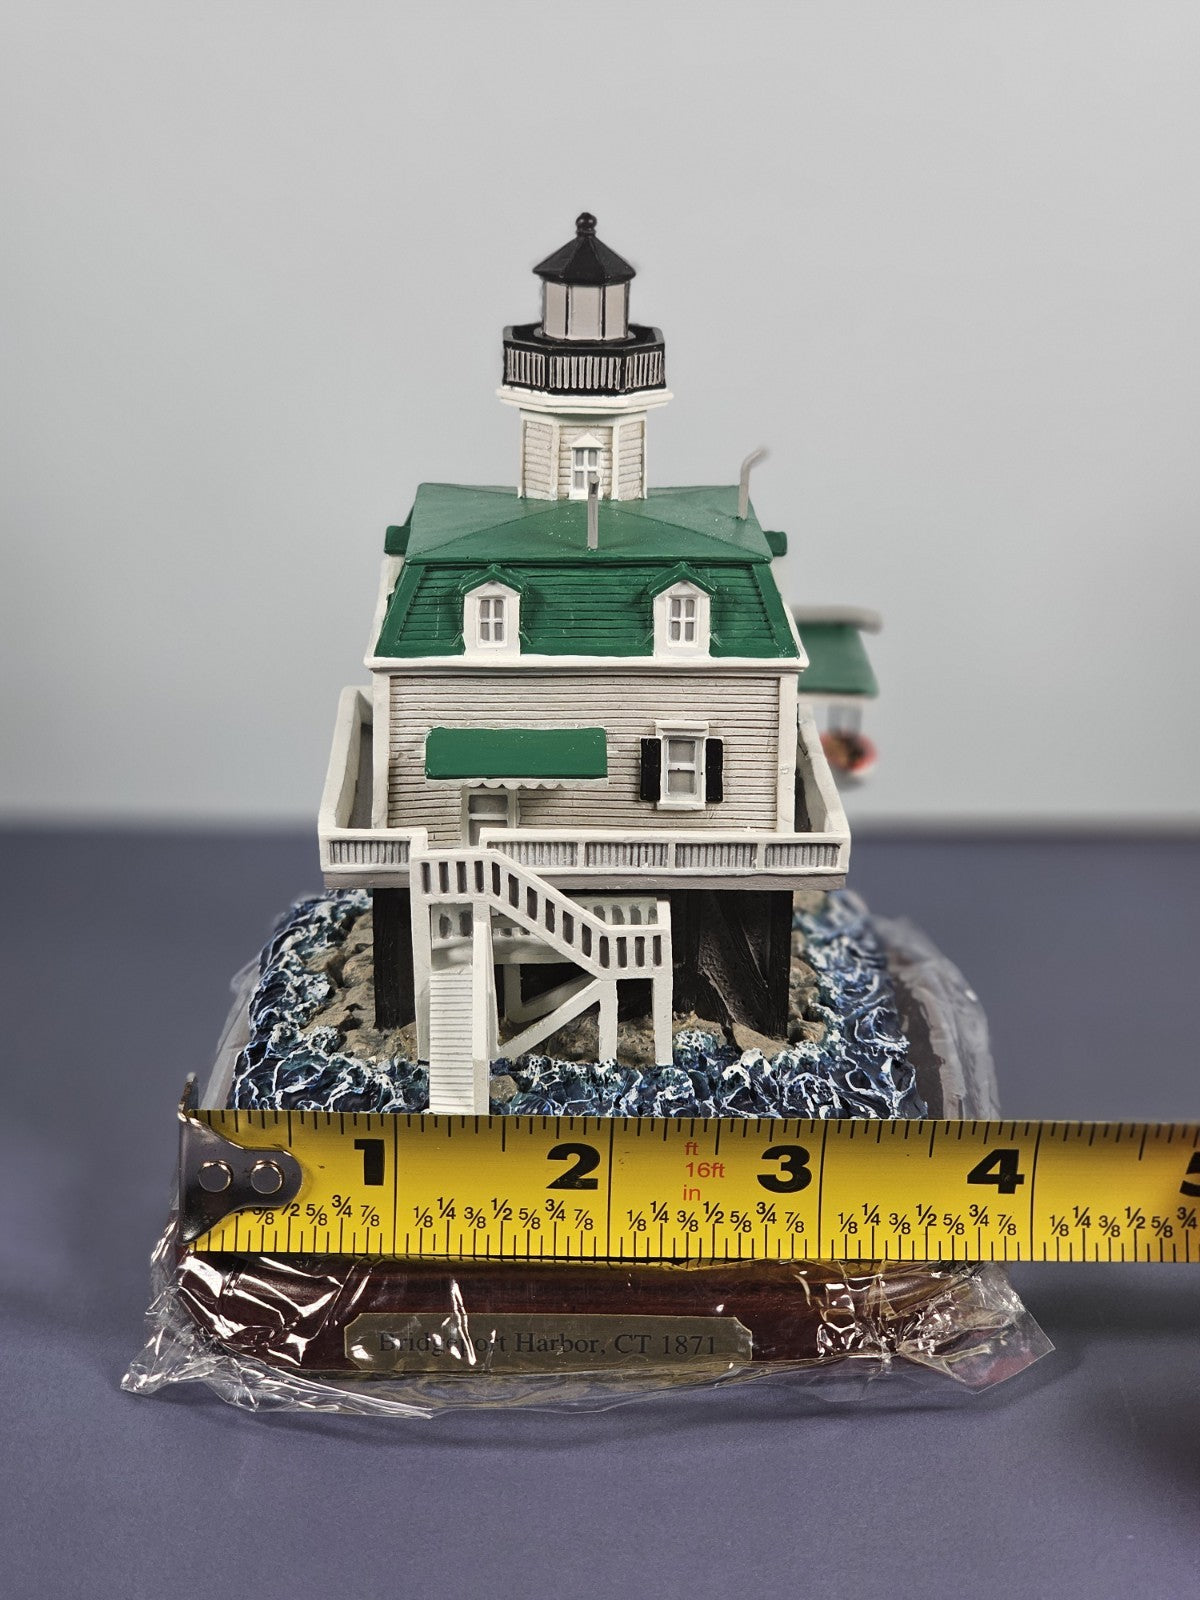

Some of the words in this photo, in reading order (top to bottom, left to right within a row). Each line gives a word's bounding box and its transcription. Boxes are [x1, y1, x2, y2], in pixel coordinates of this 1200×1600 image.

[684, 1141, 699, 1156] ft
[354, 1138, 385, 1186] 1
[545, 1142, 601, 1190] 2
[756, 1144, 812, 1194] 3
[966, 1148, 1025, 1194] 4
[685, 1162, 725, 1178] 16ft
[682, 1184, 701, 1201] in
[306, 1203, 328, 1226] 5/8
[331, 1194, 353, 1217] 3/4
[360, 1205, 380, 1226] 7/8
[413, 1206, 433, 1229] 1/8
[437, 1197, 456, 1220] 1/4
[464, 1207, 486, 1229] 3/8
[491, 1197, 513, 1221] 1/2
[518, 1208, 541, 1230] 5/8
[545, 1199, 566, 1222] 3/4
[573, 1209, 594, 1231] 7/8
[627, 1210, 646, 1232] 1/8
[650, 1201, 669, 1224] 1/4
[676, 1210, 699, 1233] 3/8
[703, 1201, 724, 1224] 1/2
[730, 1211, 752, 1233] 5/8
[756, 1202, 777, 1225] 3/4
[785, 1212, 805, 1234] 7/8
[838, 1212, 858, 1234] 1/8
[861, 1203, 881, 1226] 1/4
[889, 1213, 911, 1235] 3/8
[915, 1204, 937, 1226] 1/2
[943, 1214, 965, 1235] 5/8
[969, 1204, 990, 1227] 3/4
[997, 1214, 1017, 1236] 7/8
[1049, 1214, 1069, 1237] 1/8
[1072, 1205, 1091, 1228] 1/4
[1099, 1215, 1121, 1238] 3/8
[1124, 1206, 1145, 1229] 1/2
[1151, 1216, 1173, 1238] 5/8
[1177, 1207, 1198, 1229] 3/4
[514, 1332, 605, 1355] Harbor,
[613, 1333, 652, 1355] CT
[662, 1334, 716, 1356] 1871
